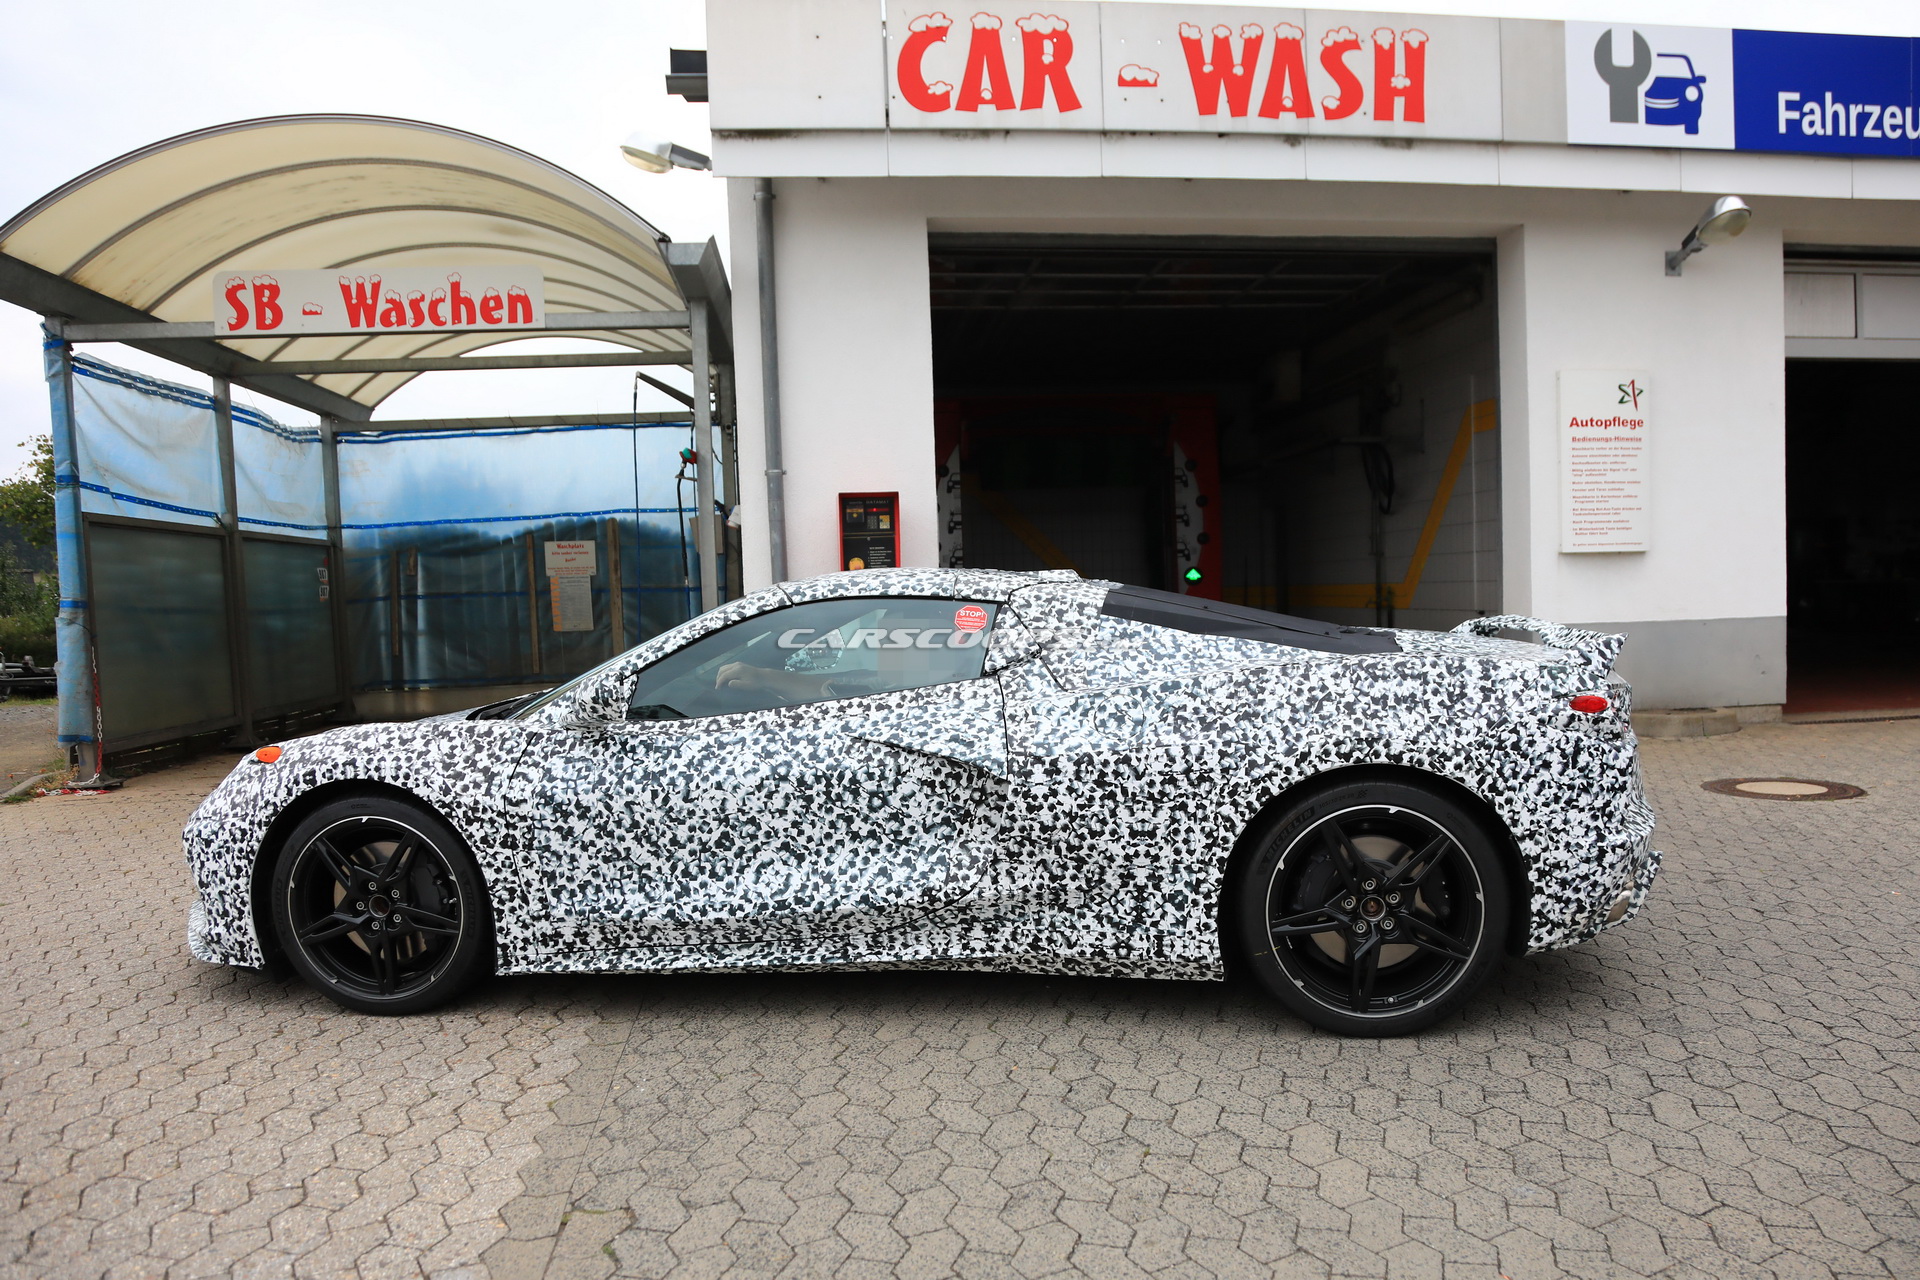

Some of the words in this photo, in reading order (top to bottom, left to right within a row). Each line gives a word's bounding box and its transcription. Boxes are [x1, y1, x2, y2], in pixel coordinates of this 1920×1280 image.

[897, 12, 1082, 113] CAR
[1179, 21, 1428, 123] WASH
[225, 274, 283, 331] SB
[338, 272, 533, 329] Waschen
[1569, 416, 1644, 430] Autopflege
[959, 609, 984, 623] STOP!
[1265, 808, 1313, 861] MICHELIN
